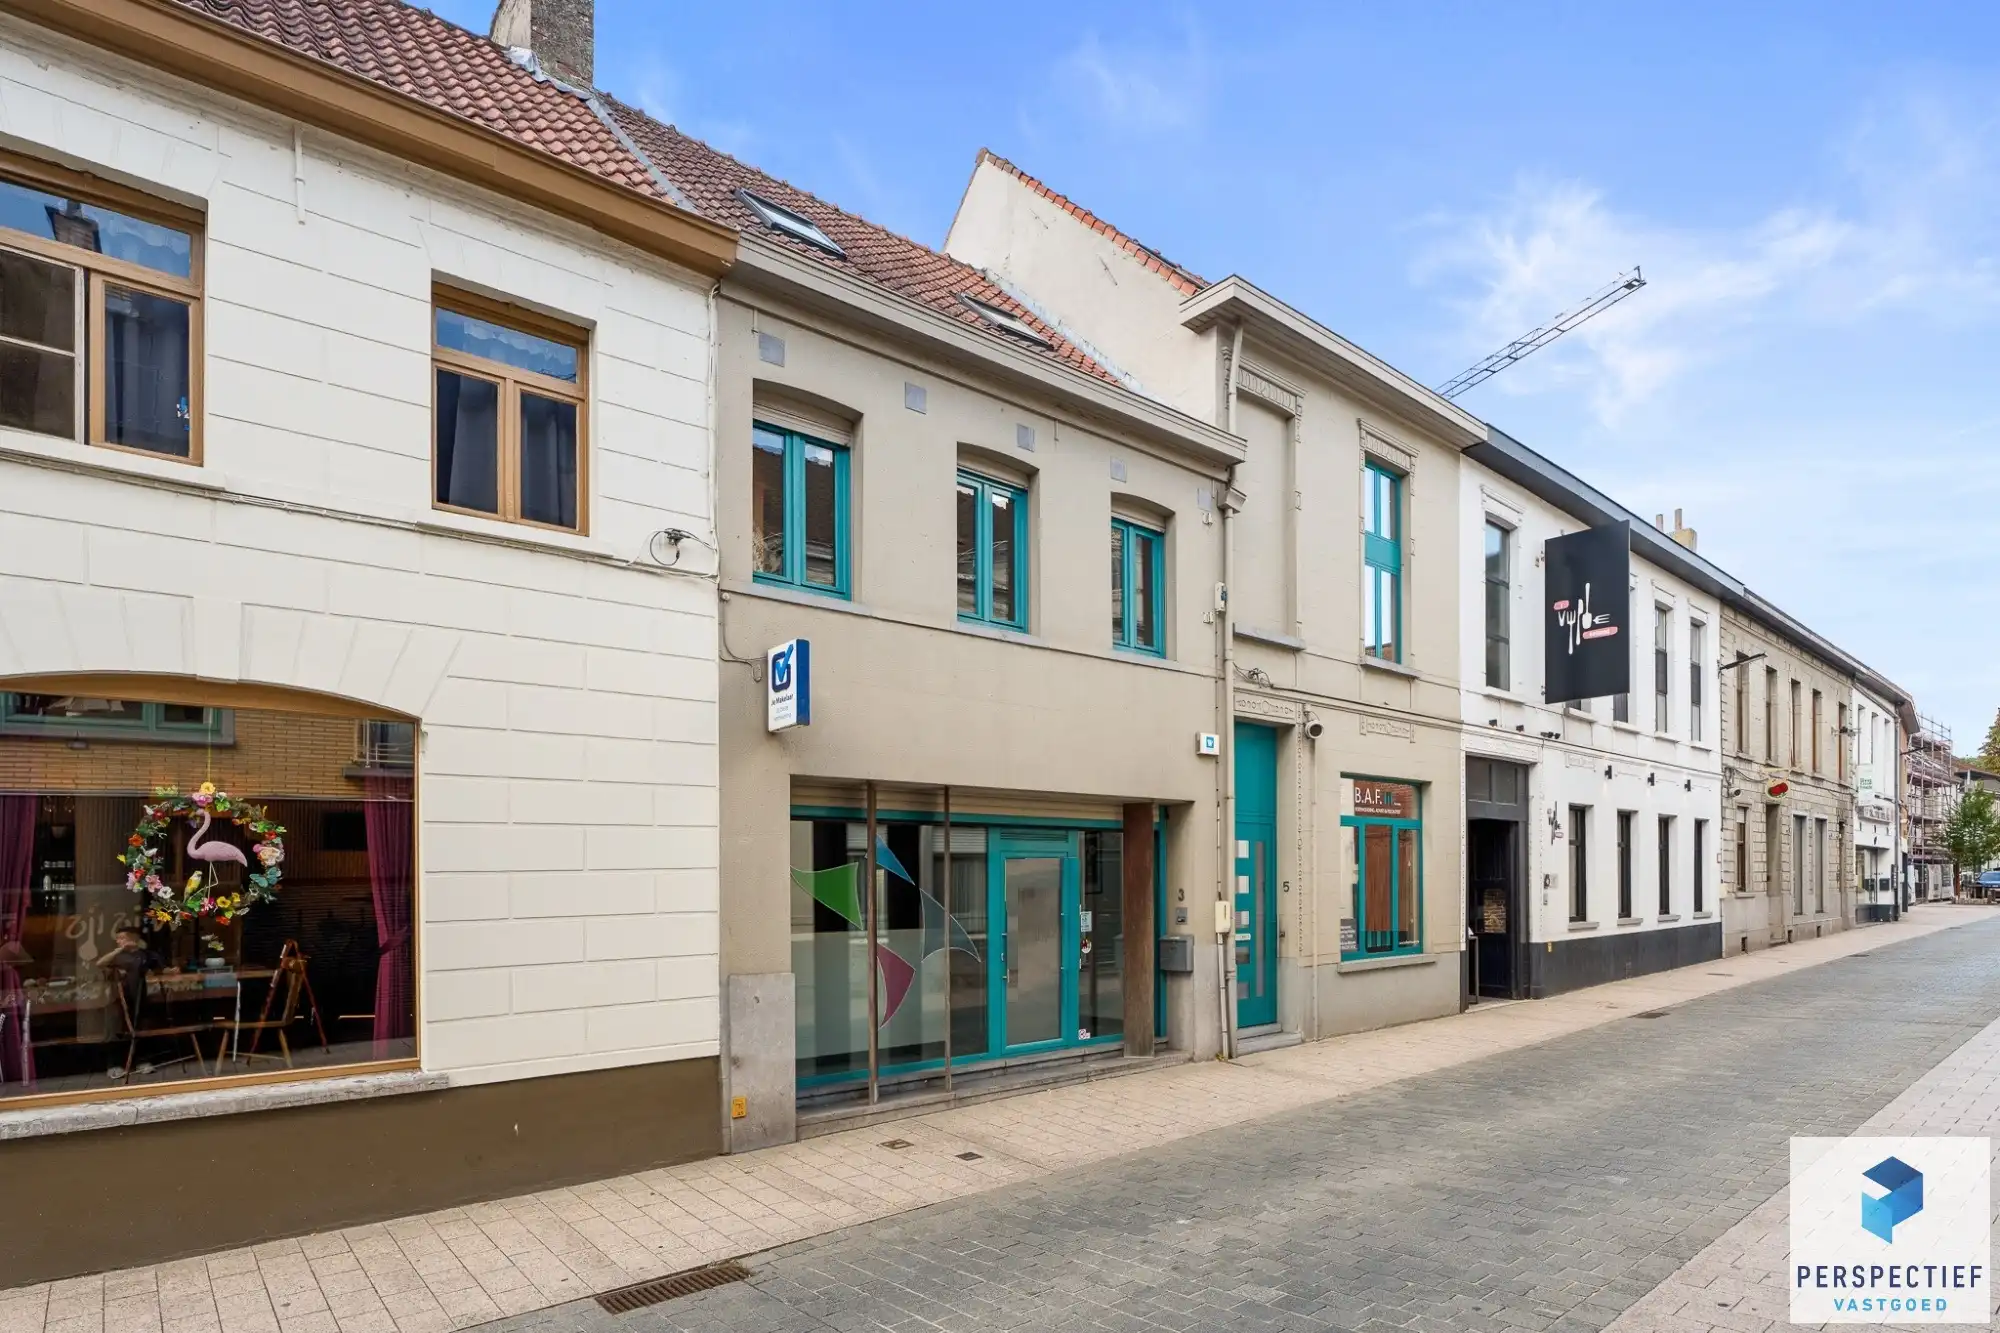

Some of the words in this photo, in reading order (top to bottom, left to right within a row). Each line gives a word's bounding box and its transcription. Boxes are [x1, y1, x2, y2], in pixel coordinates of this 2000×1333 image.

[776, 694, 793, 703] Makelaar
[1355, 787, 1382, 804] B.A.F.
[1283, 881, 1289, 893] 5
[1178, 888, 1184, 902] 3
